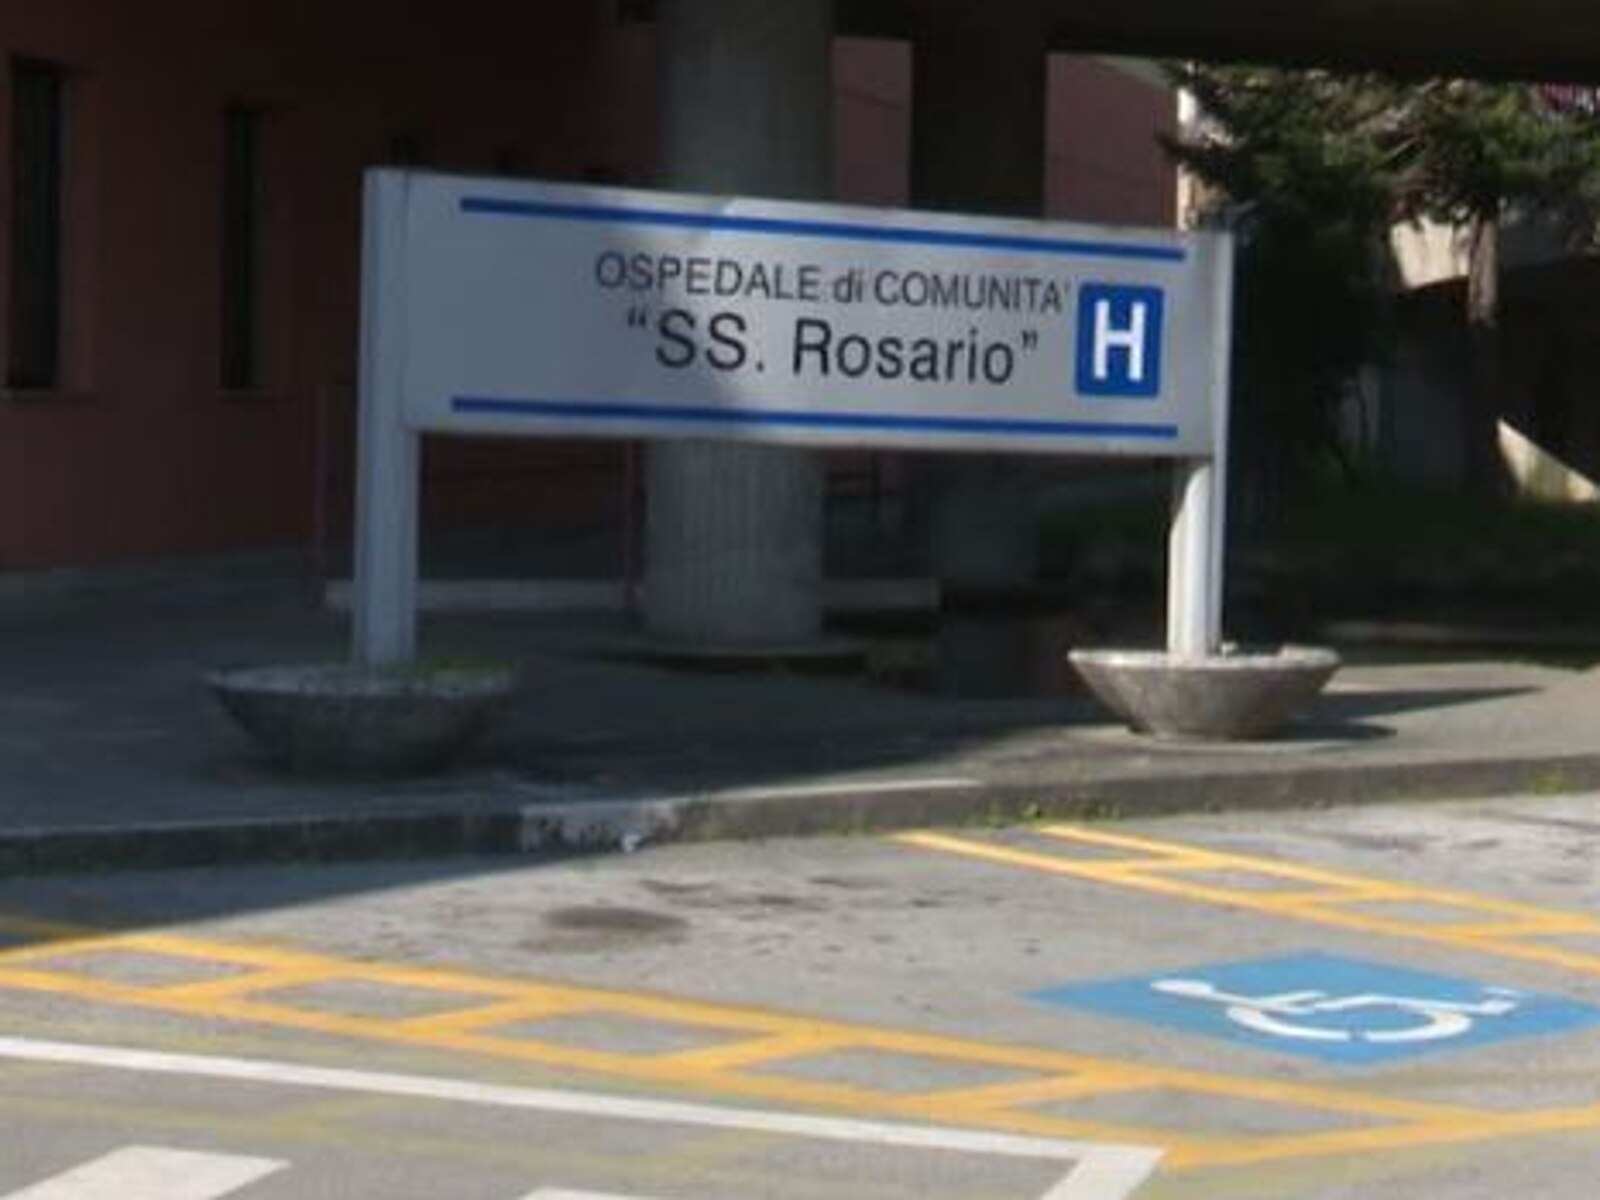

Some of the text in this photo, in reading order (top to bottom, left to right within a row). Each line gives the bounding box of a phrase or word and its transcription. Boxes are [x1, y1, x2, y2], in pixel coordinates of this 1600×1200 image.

[595, 250, 1070, 315] OSPEDALE di COMUNITA'
[793, 317, 1039, 385] Rosario”
[1092, 299, 1147, 382] H
